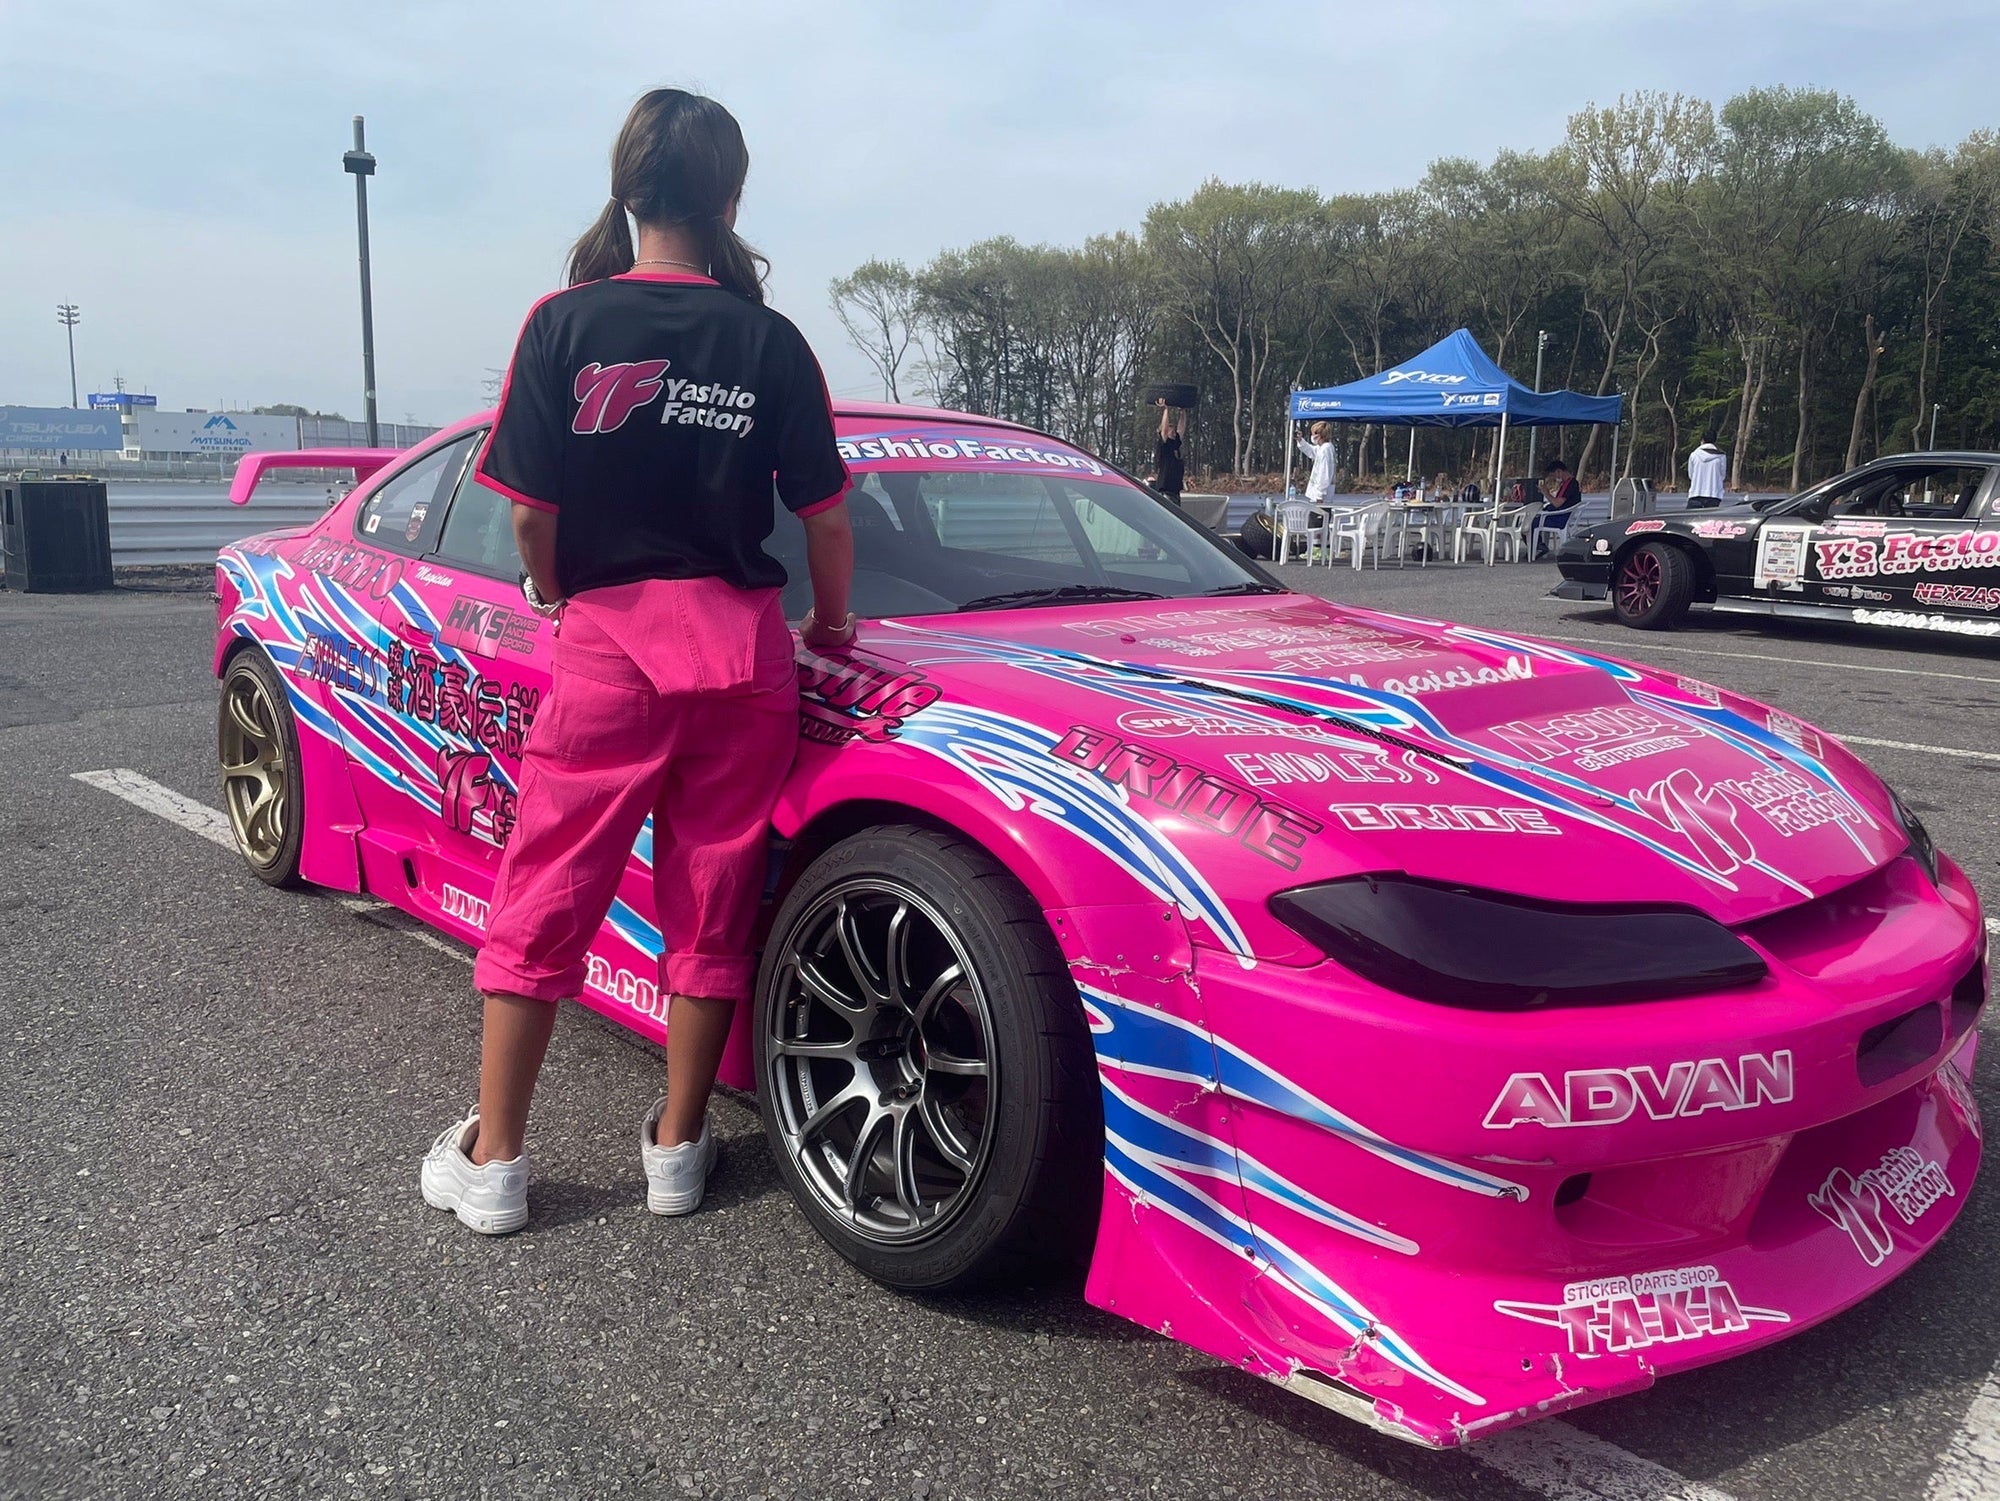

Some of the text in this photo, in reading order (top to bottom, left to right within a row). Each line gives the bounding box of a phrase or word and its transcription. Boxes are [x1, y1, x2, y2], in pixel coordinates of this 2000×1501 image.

[667, 378, 756, 409] Yashio
[1458, 395, 1480, 403] YCM
[9, 422, 107, 435] TSUKUBA
[660, 402, 755, 438] Factory
[6, 434, 63, 443] CIRCUIT
[190, 437, 252, 446] MATSUNAGA
[835, 437, 1105, 476] ashioFactory
[1817, 540, 1874, 567] Y's
[1882, 531, 2000, 561] Facto
[1822, 562, 1875, 577] Total
[1883, 560, 1918, 572] Car
[445, 599, 510, 641] HKS
[504, 625, 526, 640] AND
[509, 614, 540, 632] POWER
[500, 636, 535, 655] SPORTS
[293, 632, 380, 698] ENDLESS
[1128, 717, 1231, 729] SPEED
[1191, 724, 1327, 737] MASTER
[1489, 706, 1662, 763] N-style
[1223, 749, 1440, 787] ENDLESS
[1048, 724, 1324, 872] BRIDE
[1716, 767, 1812, 806] Yashio
[1328, 803, 1563, 836] BRIDE
[1752, 788, 1860, 838] Factory
[1482, 1048, 1795, 1130] ADVAN
[1858, 1146, 1925, 1198] Yashio
[1888, 1160, 1956, 1226] Factory
[1566, 1268, 1717, 1303] STICKER PARTS SHOP
